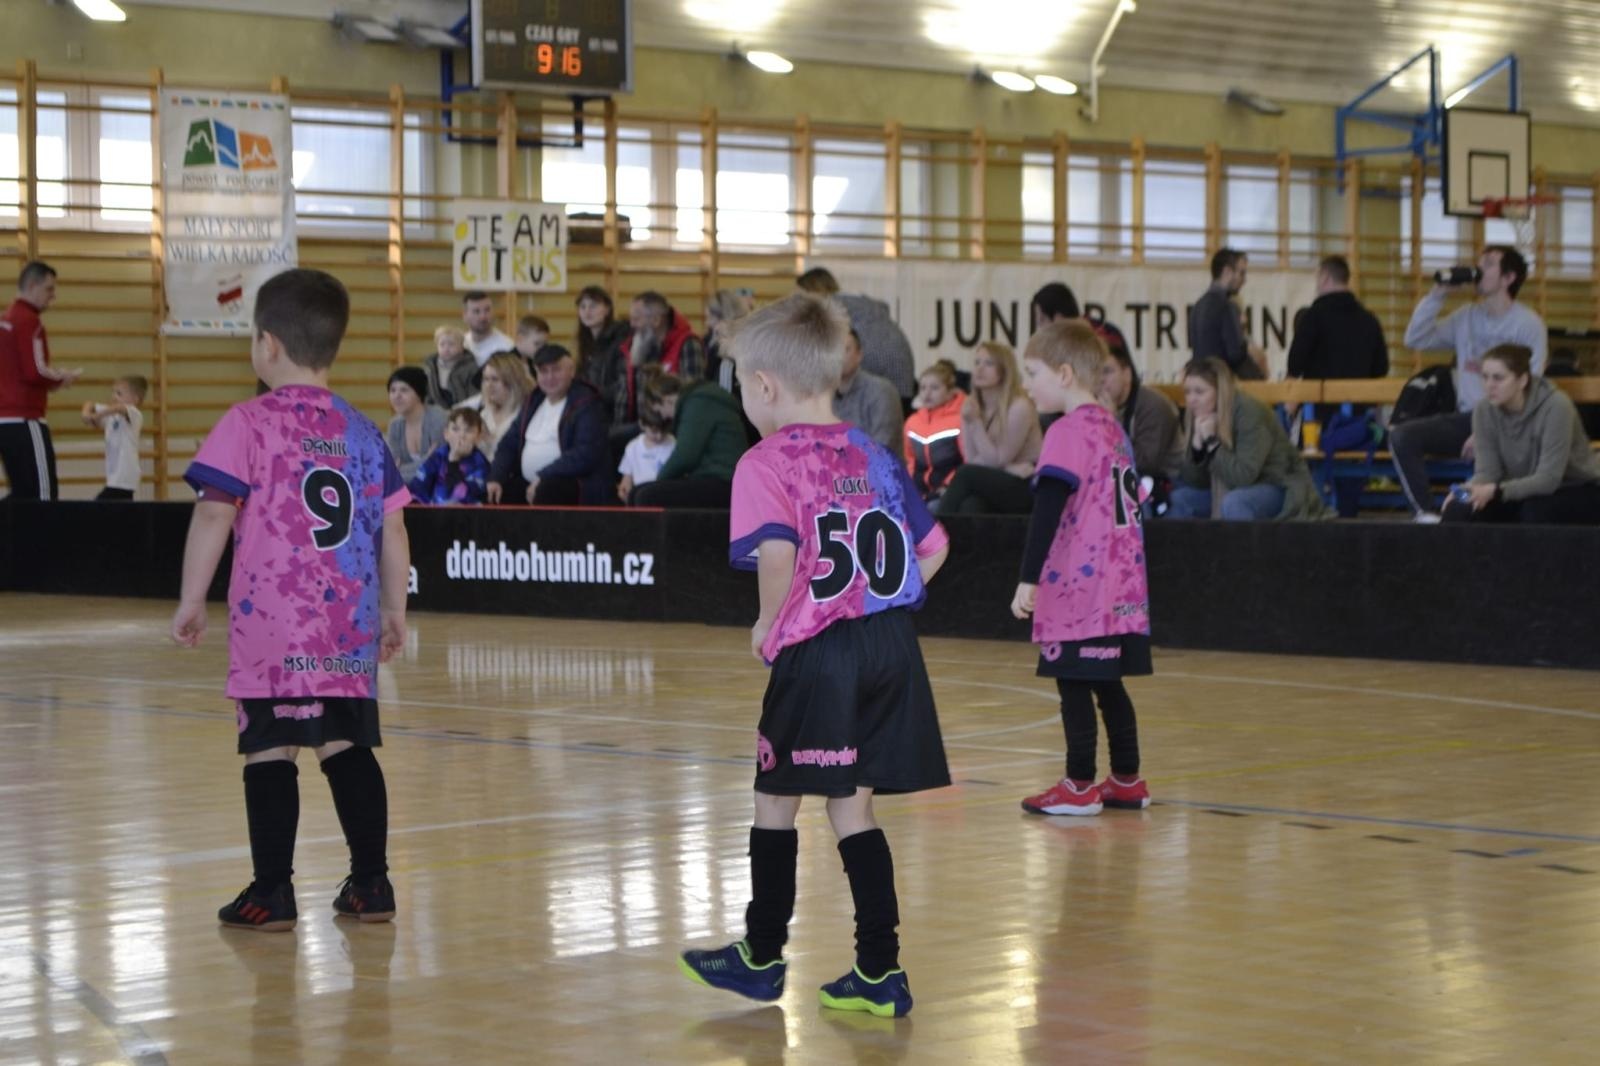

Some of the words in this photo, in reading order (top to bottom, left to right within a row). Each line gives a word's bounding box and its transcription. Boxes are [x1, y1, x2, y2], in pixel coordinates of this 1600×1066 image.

[228, 216, 275, 242] SPORT
[467, 212, 560, 246] TEAM
[168, 240, 228, 263] WIELKA
[460, 245, 562, 287] CITRUS
[928, 299, 1106, 348] JUNIR
[303, 466, 353, 550] 9
[446, 540, 655, 585] ddmbohumin.cz
[809, 507, 908, 602] 50
[283, 656, 318, 671] MSK
